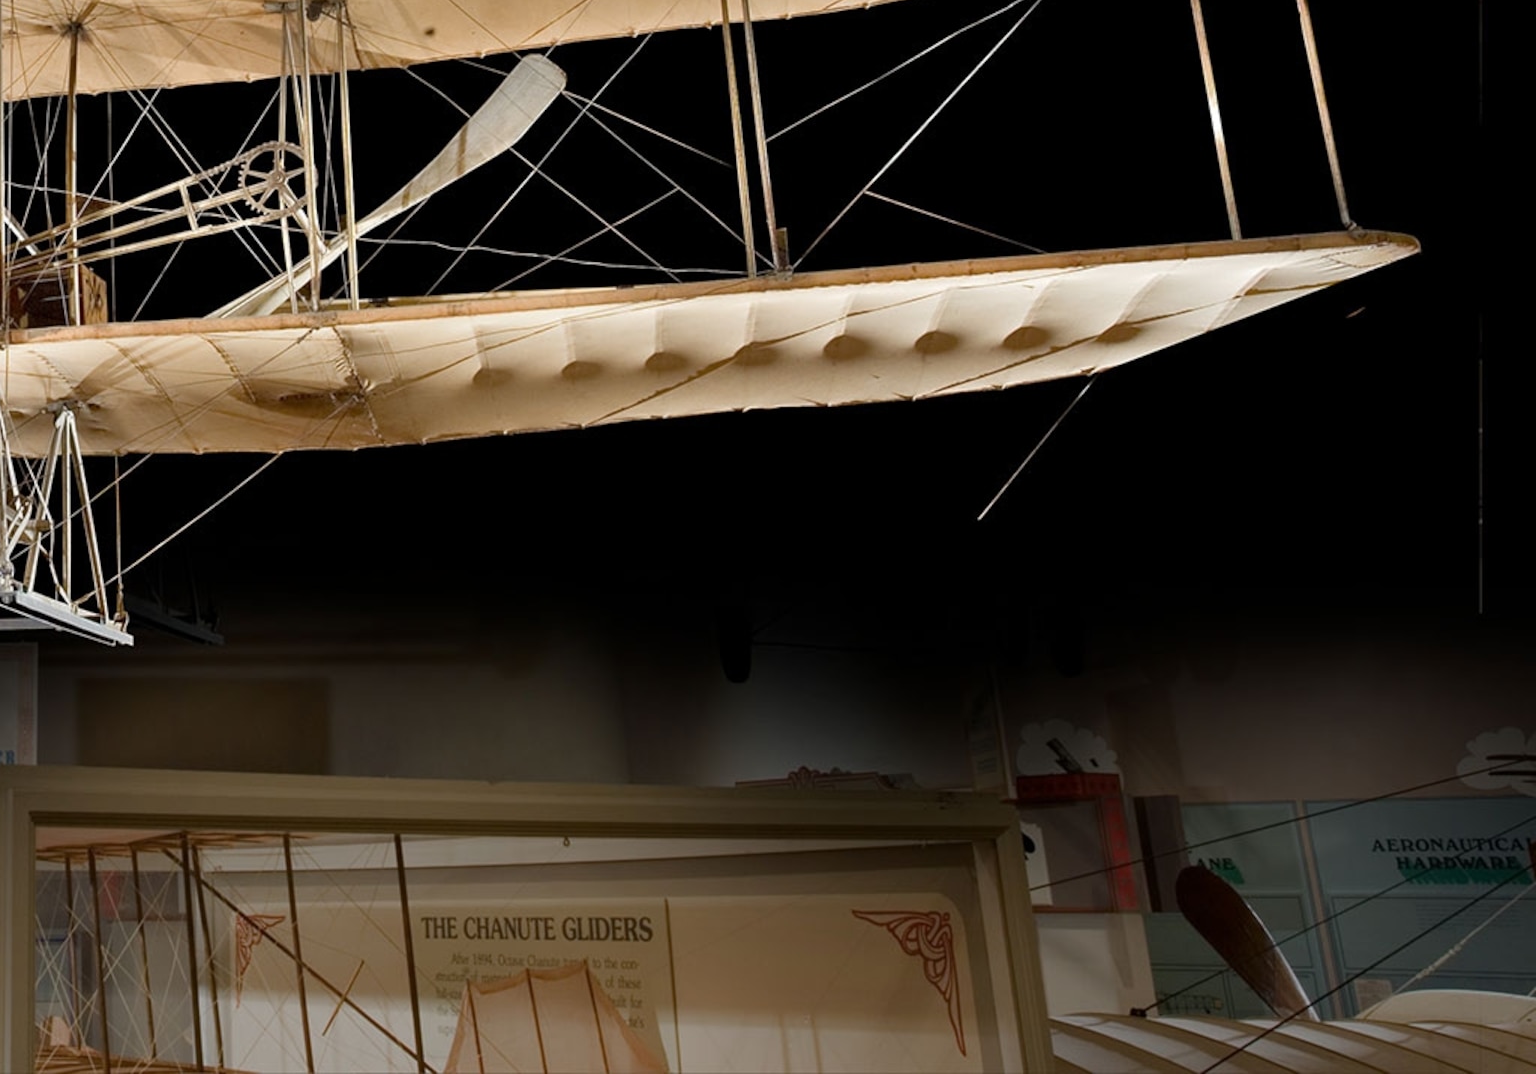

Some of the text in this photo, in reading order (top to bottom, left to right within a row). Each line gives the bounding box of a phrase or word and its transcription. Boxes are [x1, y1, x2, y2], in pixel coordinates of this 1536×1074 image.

[1396, 856, 1523, 870] HARDWARE
[421, 916, 654, 942] THE CHANUTE GLIDERS
